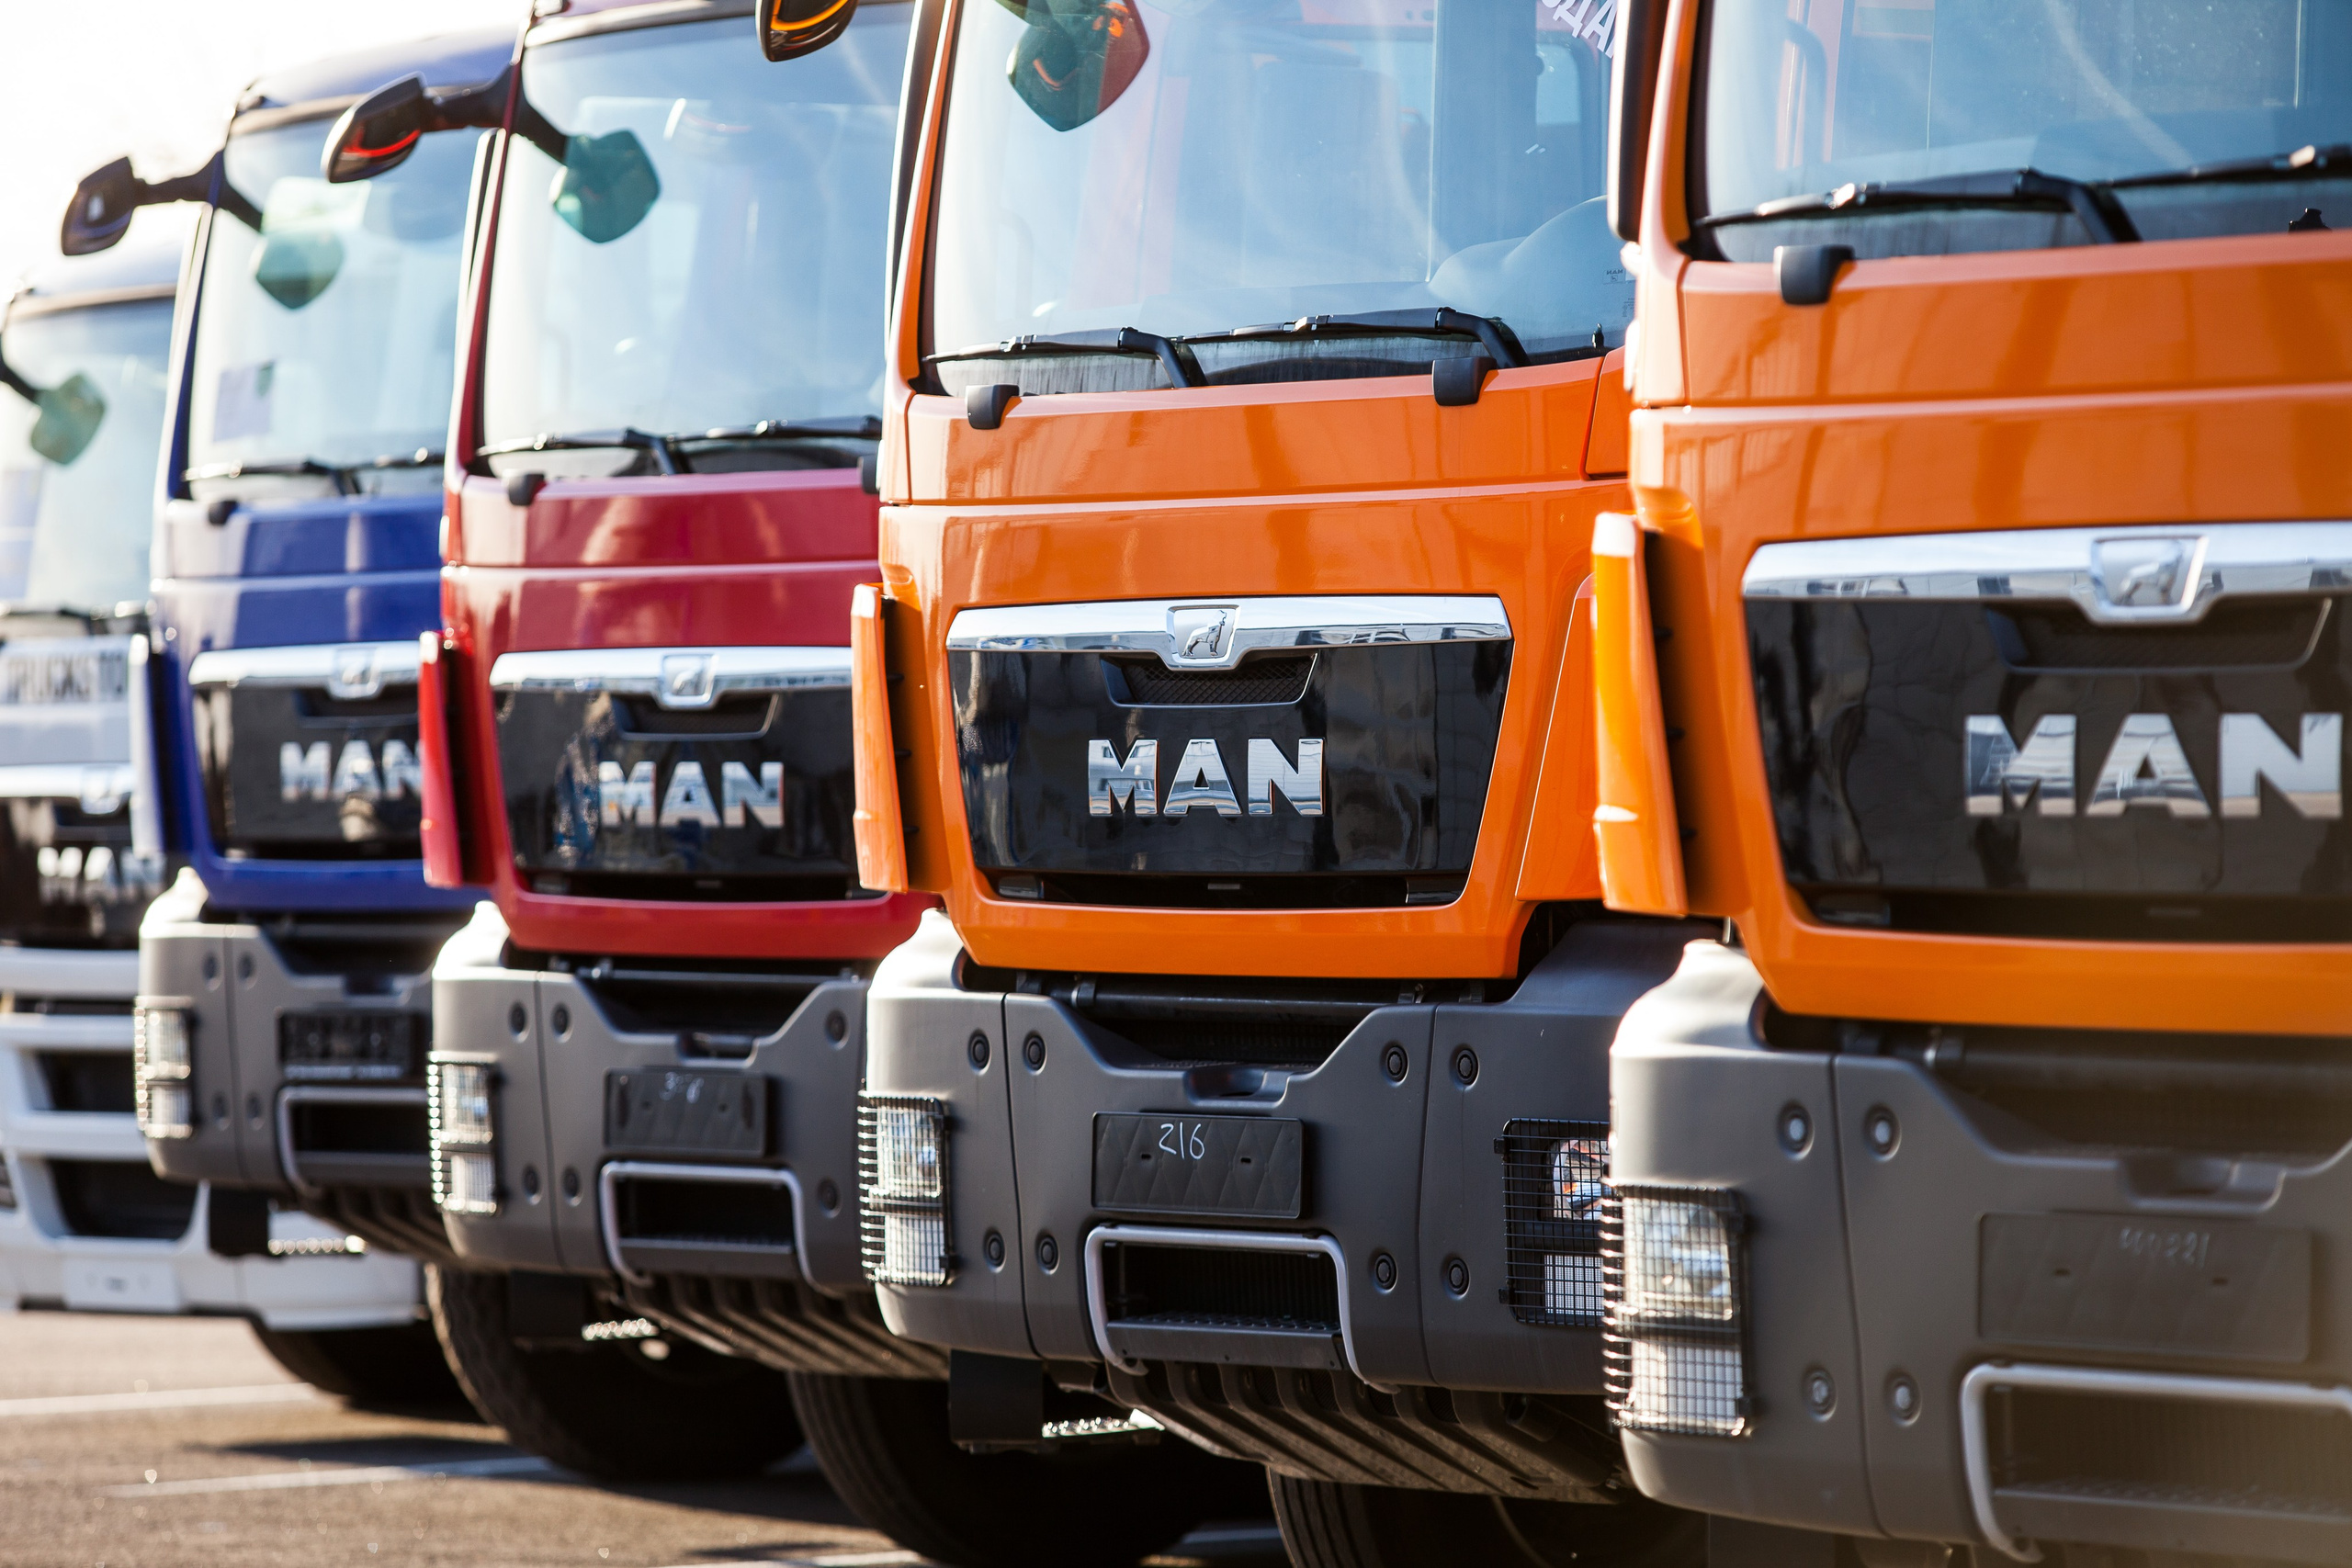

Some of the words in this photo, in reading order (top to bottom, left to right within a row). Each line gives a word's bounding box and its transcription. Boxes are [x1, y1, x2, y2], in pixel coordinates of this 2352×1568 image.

[280, 739, 424, 803] MAN
[598, 761, 785, 828] MAN
[1088, 738, 1325, 817] MAN
[1964, 712, 2343, 818] MAN
[1159, 1122, 1205, 1160] 216
